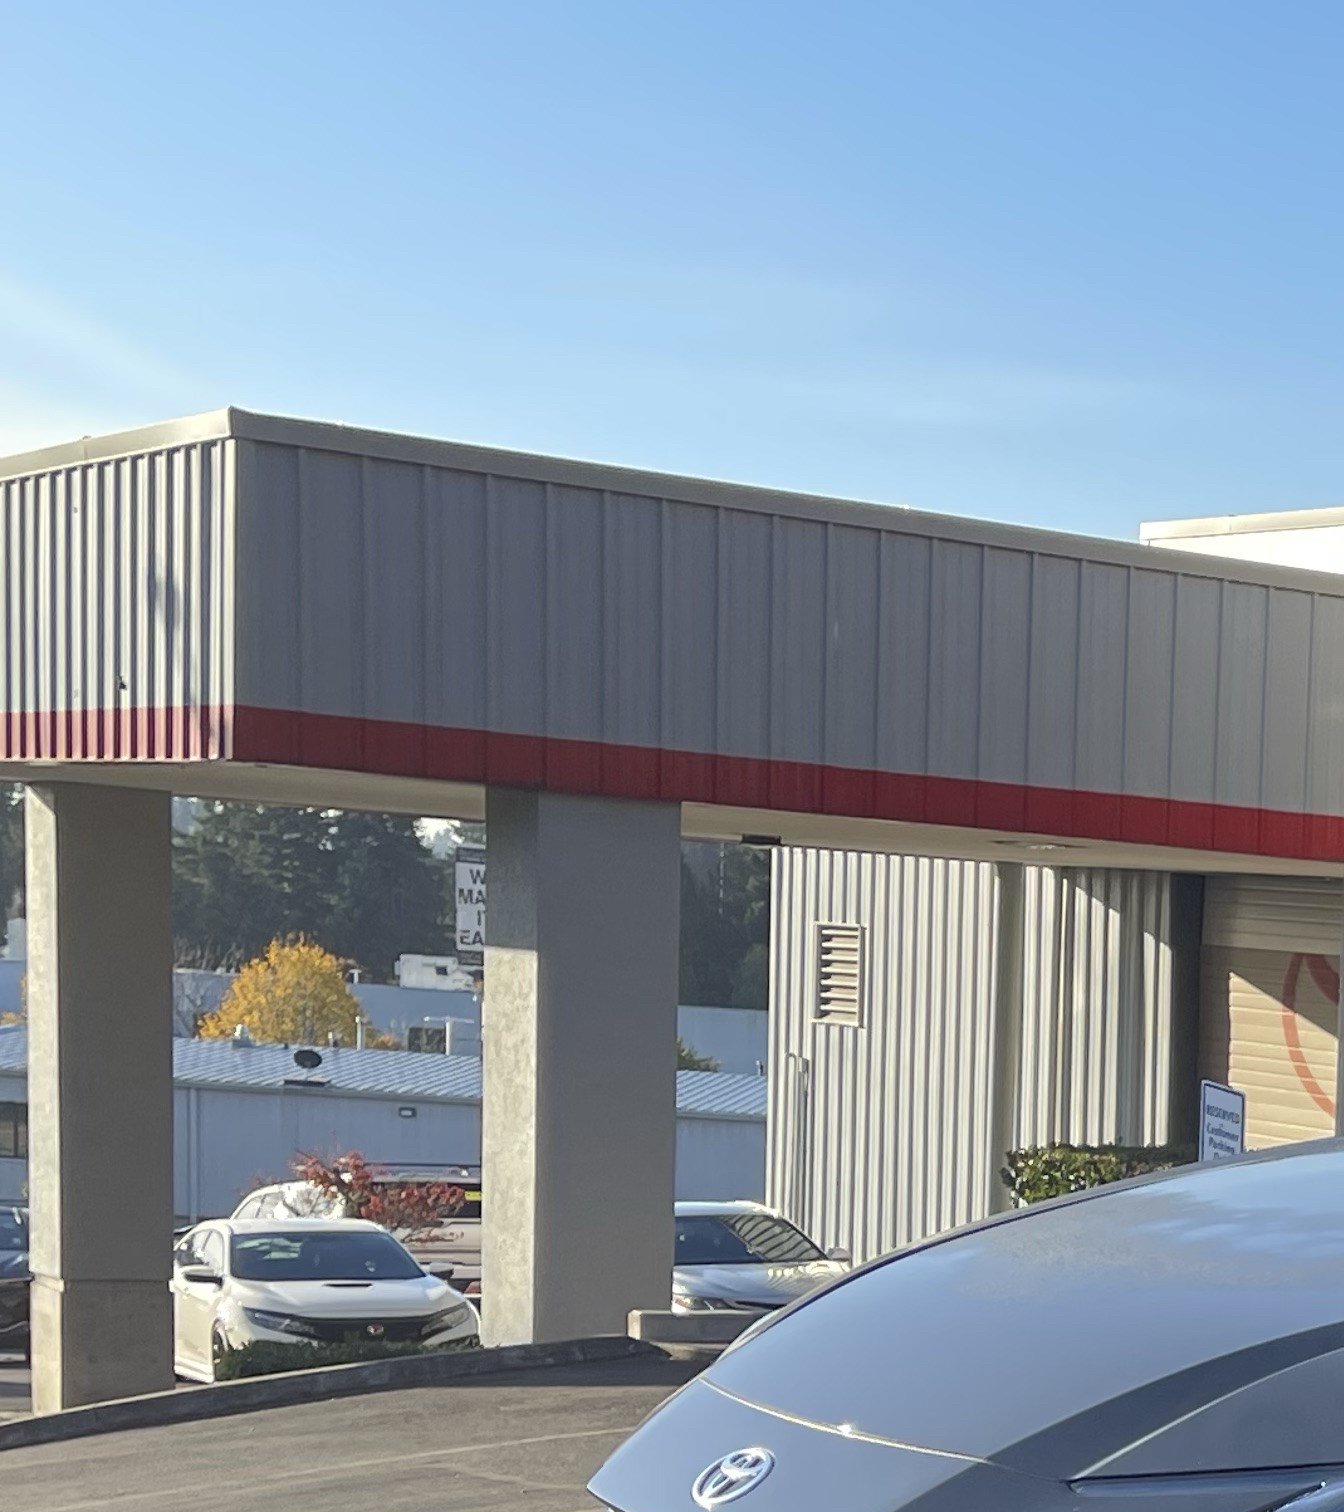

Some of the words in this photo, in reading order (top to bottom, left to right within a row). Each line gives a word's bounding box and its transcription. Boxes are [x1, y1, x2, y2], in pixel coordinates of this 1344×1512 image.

[470, 868, 487, 885] W
[458, 888, 487, 905] MA
[458, 929, 485, 946] EA
[1206, 1104, 1240, 1125] RESERVED
